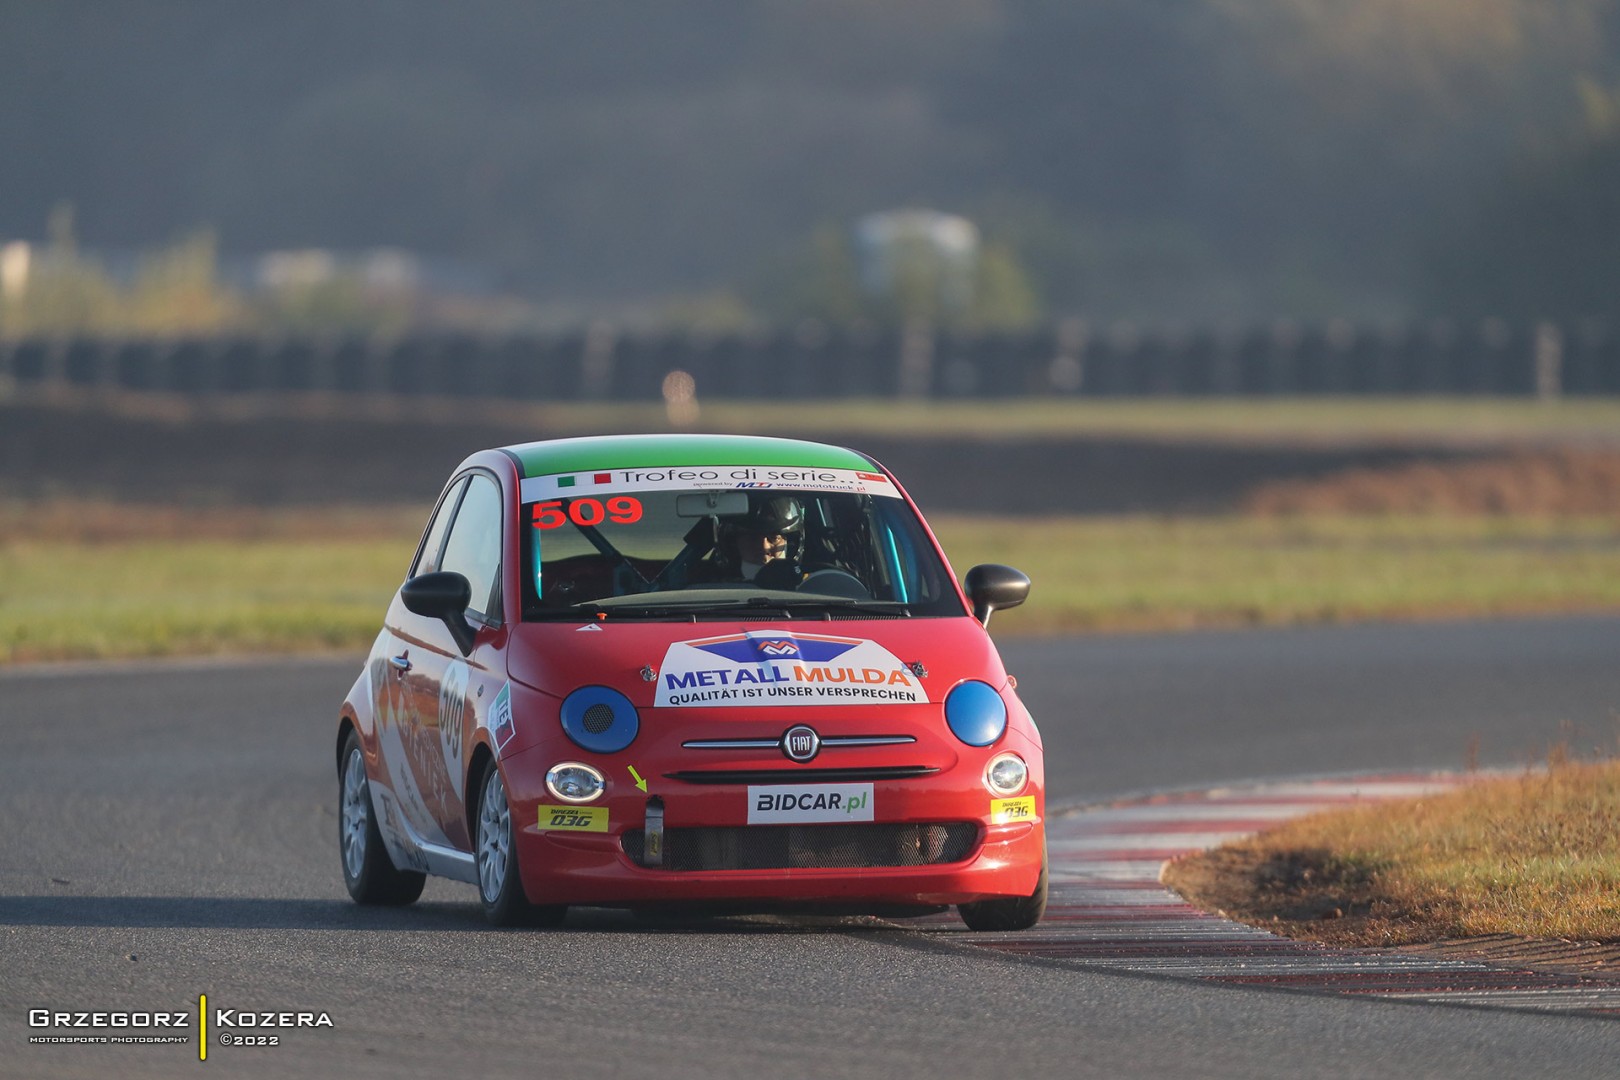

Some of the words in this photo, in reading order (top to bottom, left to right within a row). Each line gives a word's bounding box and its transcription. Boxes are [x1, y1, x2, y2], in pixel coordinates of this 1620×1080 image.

[620, 469, 718, 483] Trofeo
[730, 468, 756, 480] di
[532, 496, 643, 529] 509
[665, 666, 790, 690] METALL
[793, 666, 912, 687] MULDA
[669, 688, 738, 705] QUALITÄT
[742, 688, 763, 698] IST
[767, 687, 813, 697] UNSER
[816, 687, 916, 702] VERSPRECHEN
[791, 735, 811, 751] FIAT
[757, 791, 868, 813] BIDCAR.pl
[550, 815, 592, 827] 03G
